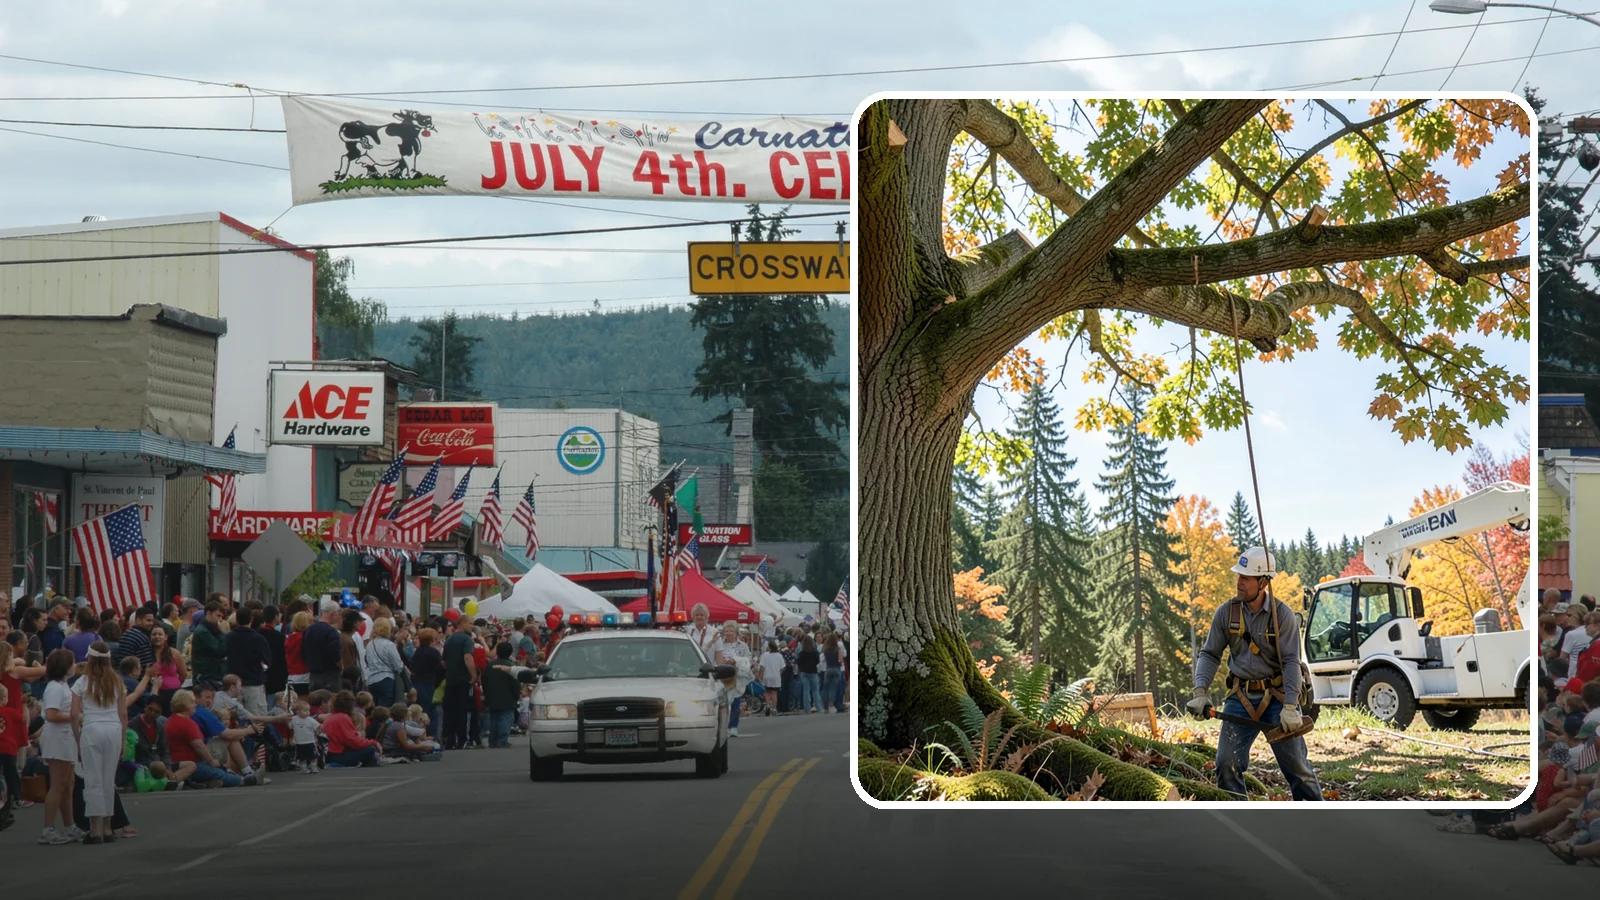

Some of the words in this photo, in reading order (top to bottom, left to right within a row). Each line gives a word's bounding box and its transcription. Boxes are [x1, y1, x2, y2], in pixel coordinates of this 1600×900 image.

[481, 141, 605, 192] JULY
[632, 150, 746, 198] 4th.
[697, 254, 850, 280] CROSSWA
[283, 380, 374, 420] ACE
[406, 409, 452, 422] CEDAR
[283, 421, 371, 436] Hardware
[416, 428, 477, 446] Coca-Cola
[95, 485, 125, 495] Vincent
[126, 486, 136, 495] de
[137, 486, 155, 495] Paul
[688, 526, 741, 535] CRNATION
[699, 535, 730, 543] GLASS
